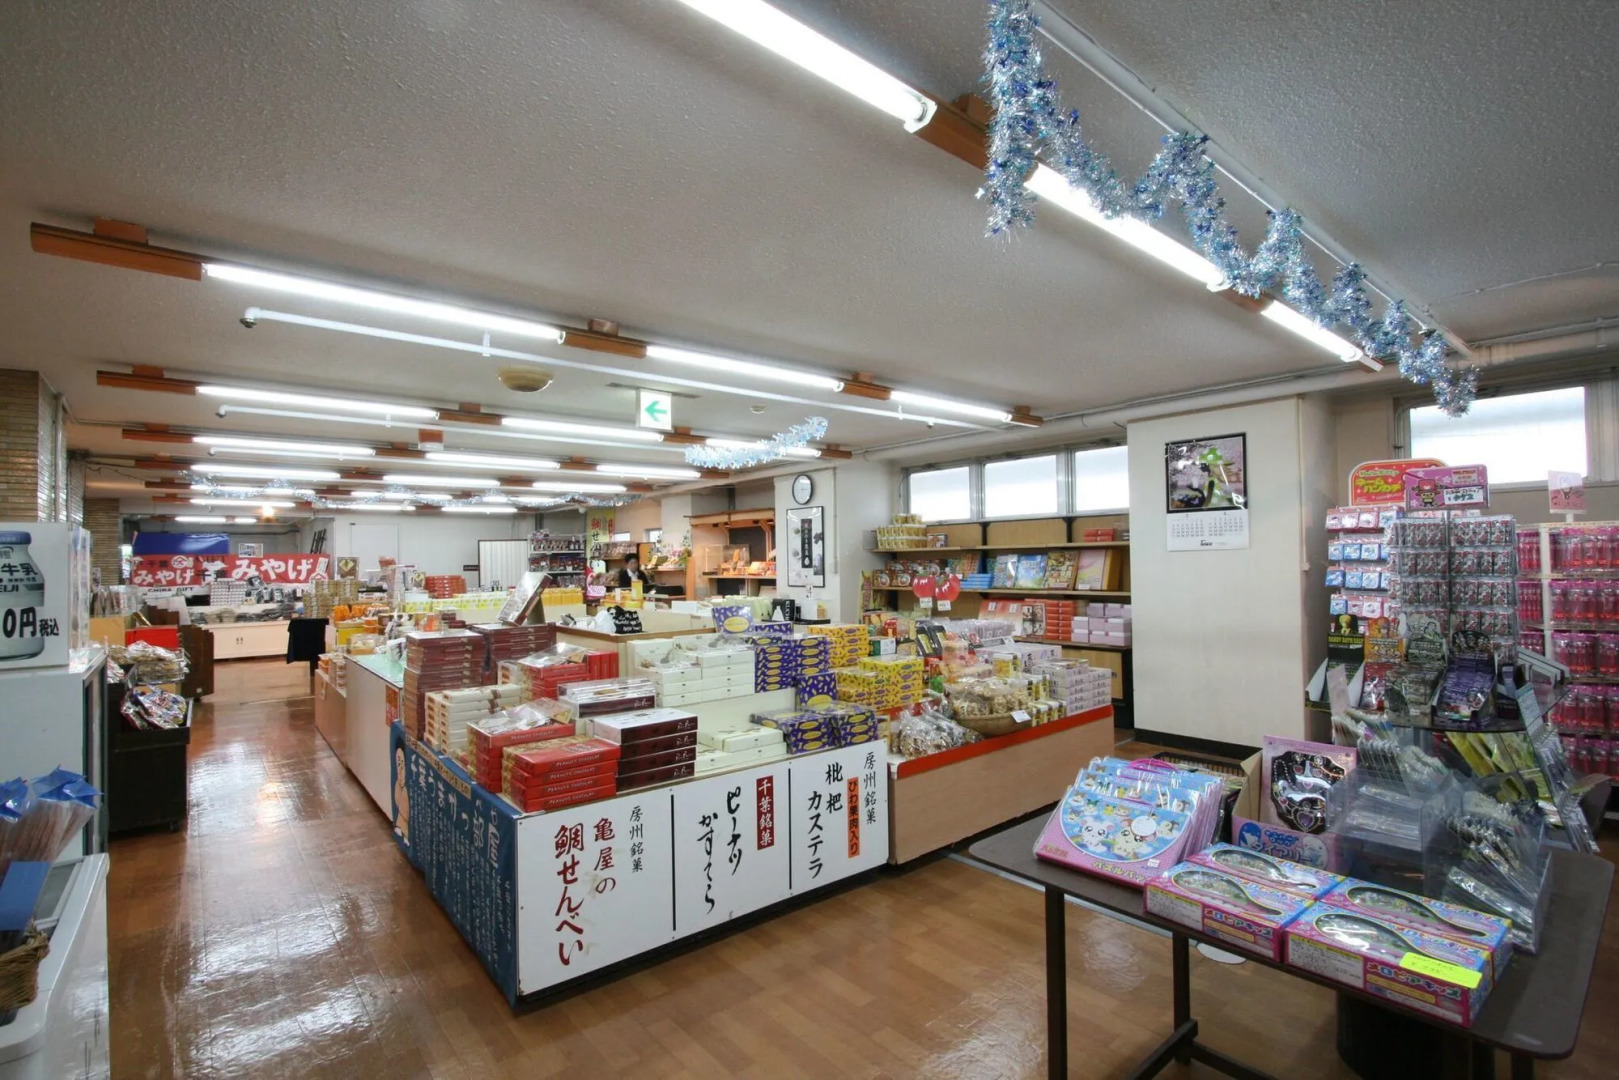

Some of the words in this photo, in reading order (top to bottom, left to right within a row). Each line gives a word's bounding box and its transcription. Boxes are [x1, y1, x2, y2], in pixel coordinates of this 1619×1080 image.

[133, 568, 195, 585] みやげ
[231, 558, 313, 580] みやげ
[757, 778, 774, 847] 千葉銘菓
[825, 762, 843, 815] 枇杷
[847, 780, 860, 856] びわ果肉入り
[863, 751, 877, 824] 房州銘菓
[593, 817, 617, 895] 亀屋の
[629, 805, 644, 873] 房州銘菓
[696, 811, 719, 915] かすてら
[807, 790, 824, 880] カステラ
[553, 822, 585, 966] 鯛せんべい
